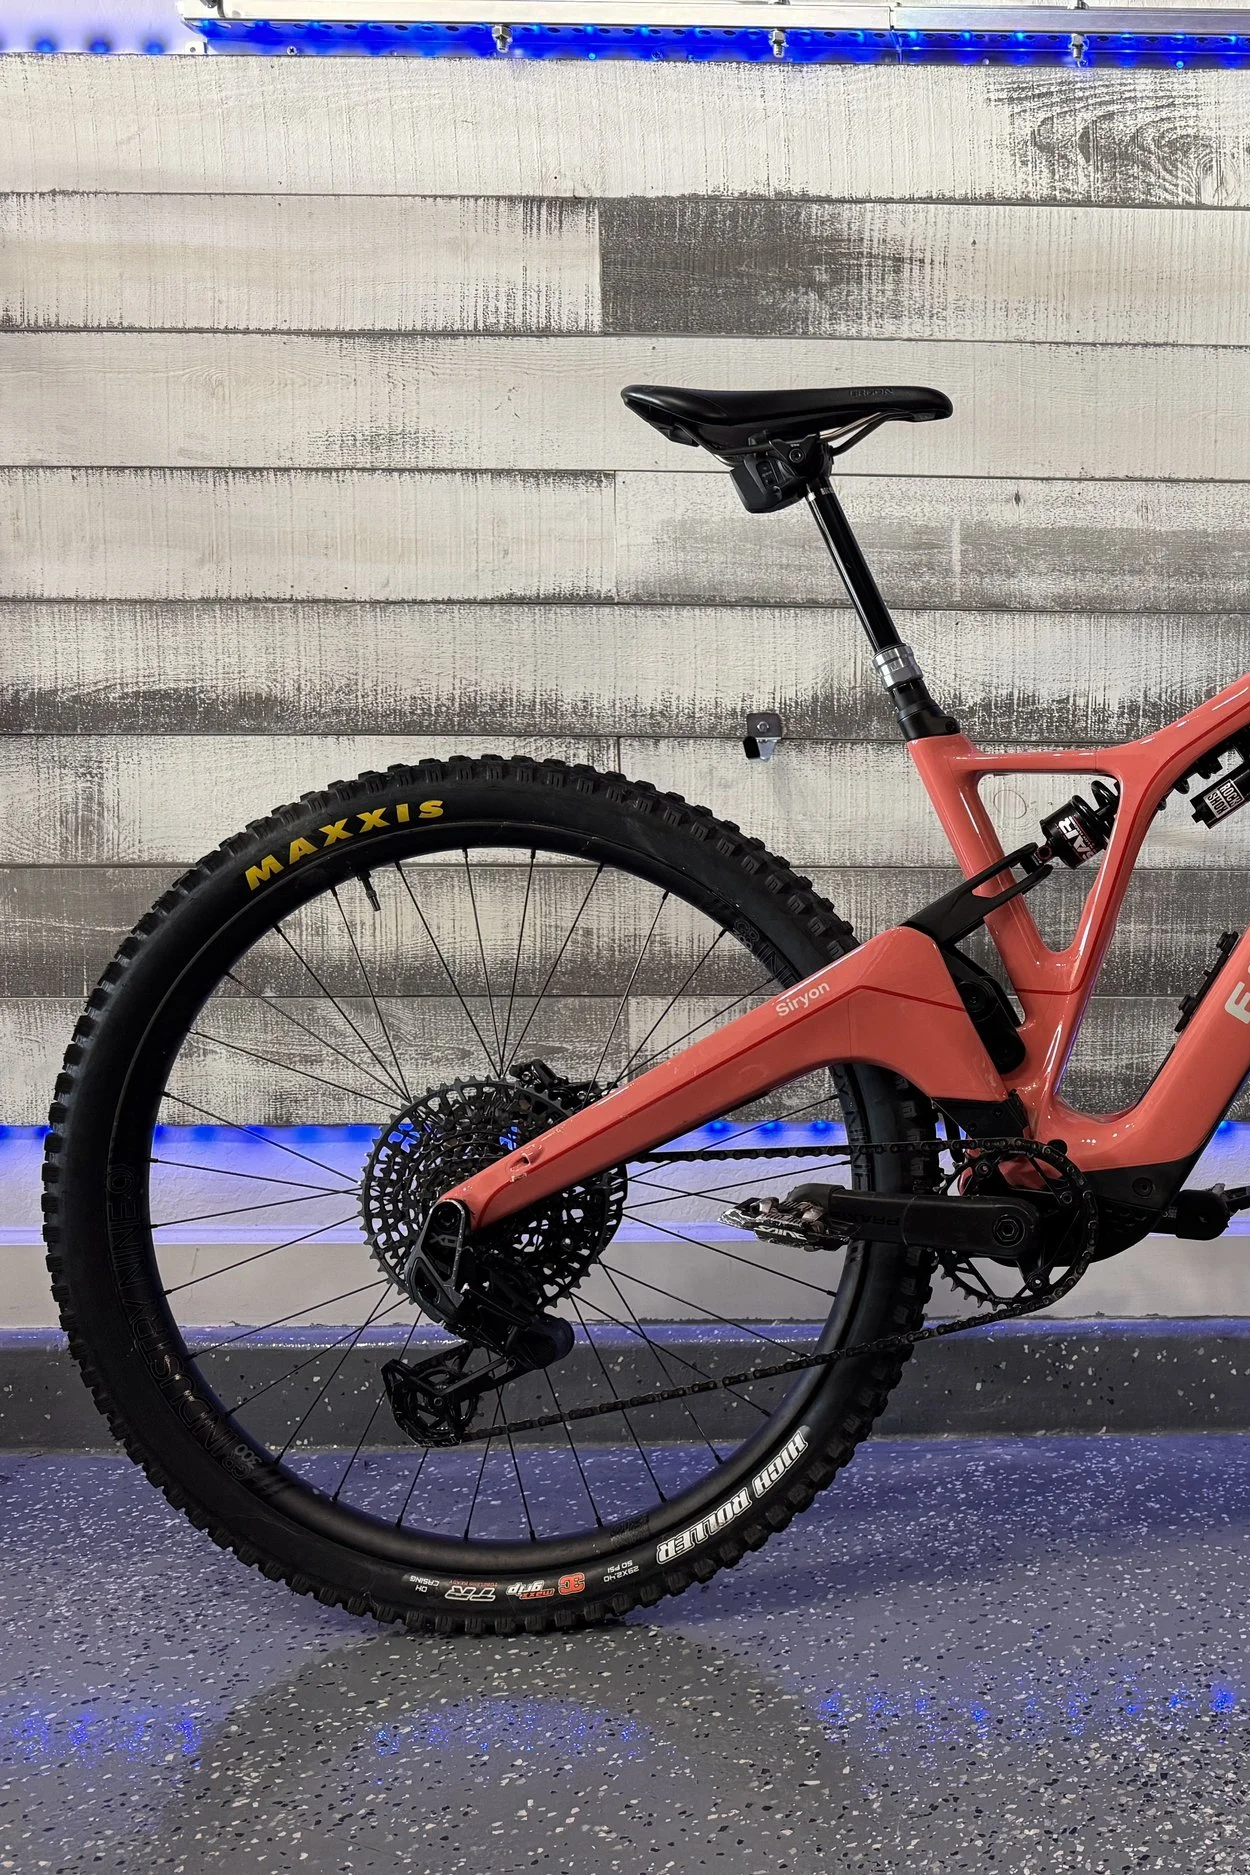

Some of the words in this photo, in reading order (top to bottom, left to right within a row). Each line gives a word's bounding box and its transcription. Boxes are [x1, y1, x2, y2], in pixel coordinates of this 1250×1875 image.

[1206, 791, 1229, 815] SHOX
[1218, 780, 1243, 809] ROCK
[244, 800, 444, 891] MAXXIS
[775, 982, 831, 1017] Siryon
[106, 1200, 151, 1290] NINE
[123, 1300, 236, 1460] INDUSTRY
[753, 1425, 810, 1498] HIGH
[656, 1487, 752, 1565] ROLLER
[409, 1574, 440, 1587] CASING
[603, 1565, 640, 1583] 29X2.40
[607, 1564, 620, 1573] PSI
[414, 1584, 428, 1594] DH
[444, 1584, 496, 1602] TR
[505, 1579, 545, 1597] grip
[518, 1588, 555, 1600] maxx
